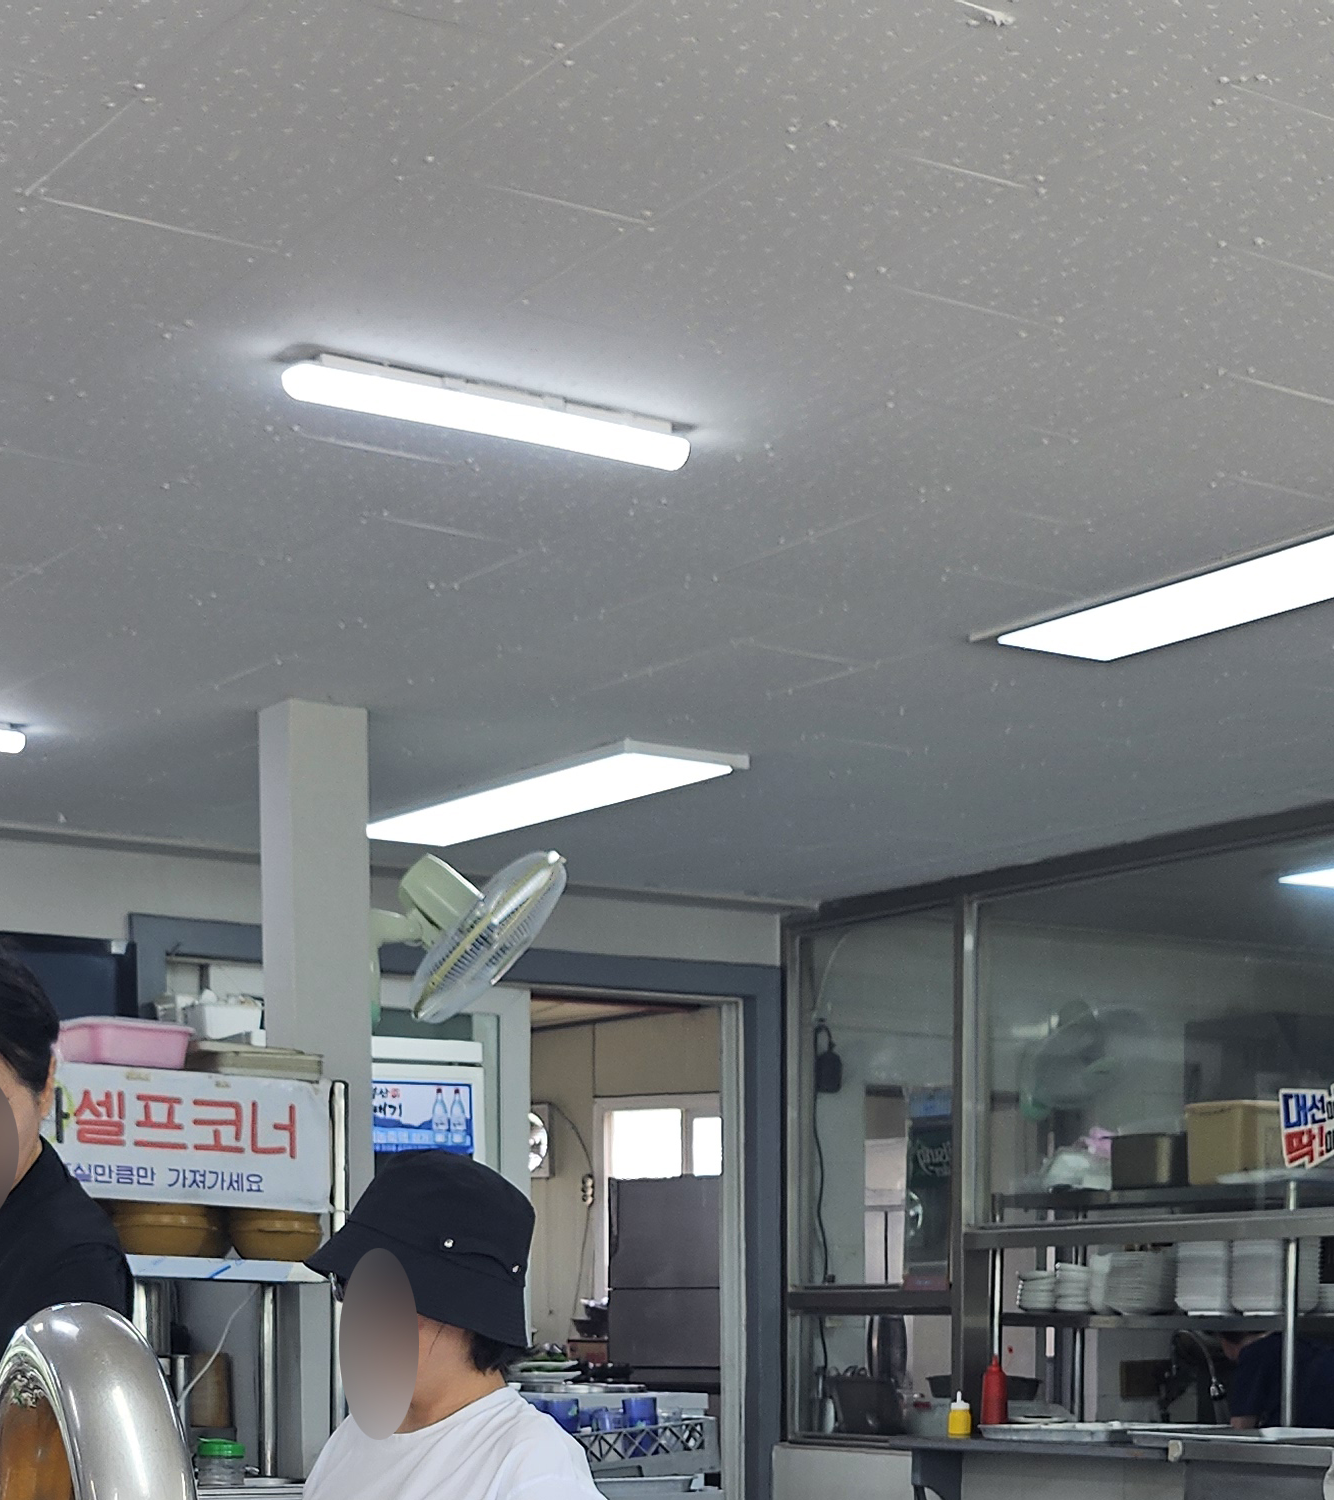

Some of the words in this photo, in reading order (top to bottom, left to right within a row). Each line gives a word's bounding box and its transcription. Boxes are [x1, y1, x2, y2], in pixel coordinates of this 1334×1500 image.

[74, 1089, 297, 1160] 셀프코너
[66, 1162, 157, 1186] 실만큼만
[167, 1167, 265, 1193] 가져가세요
